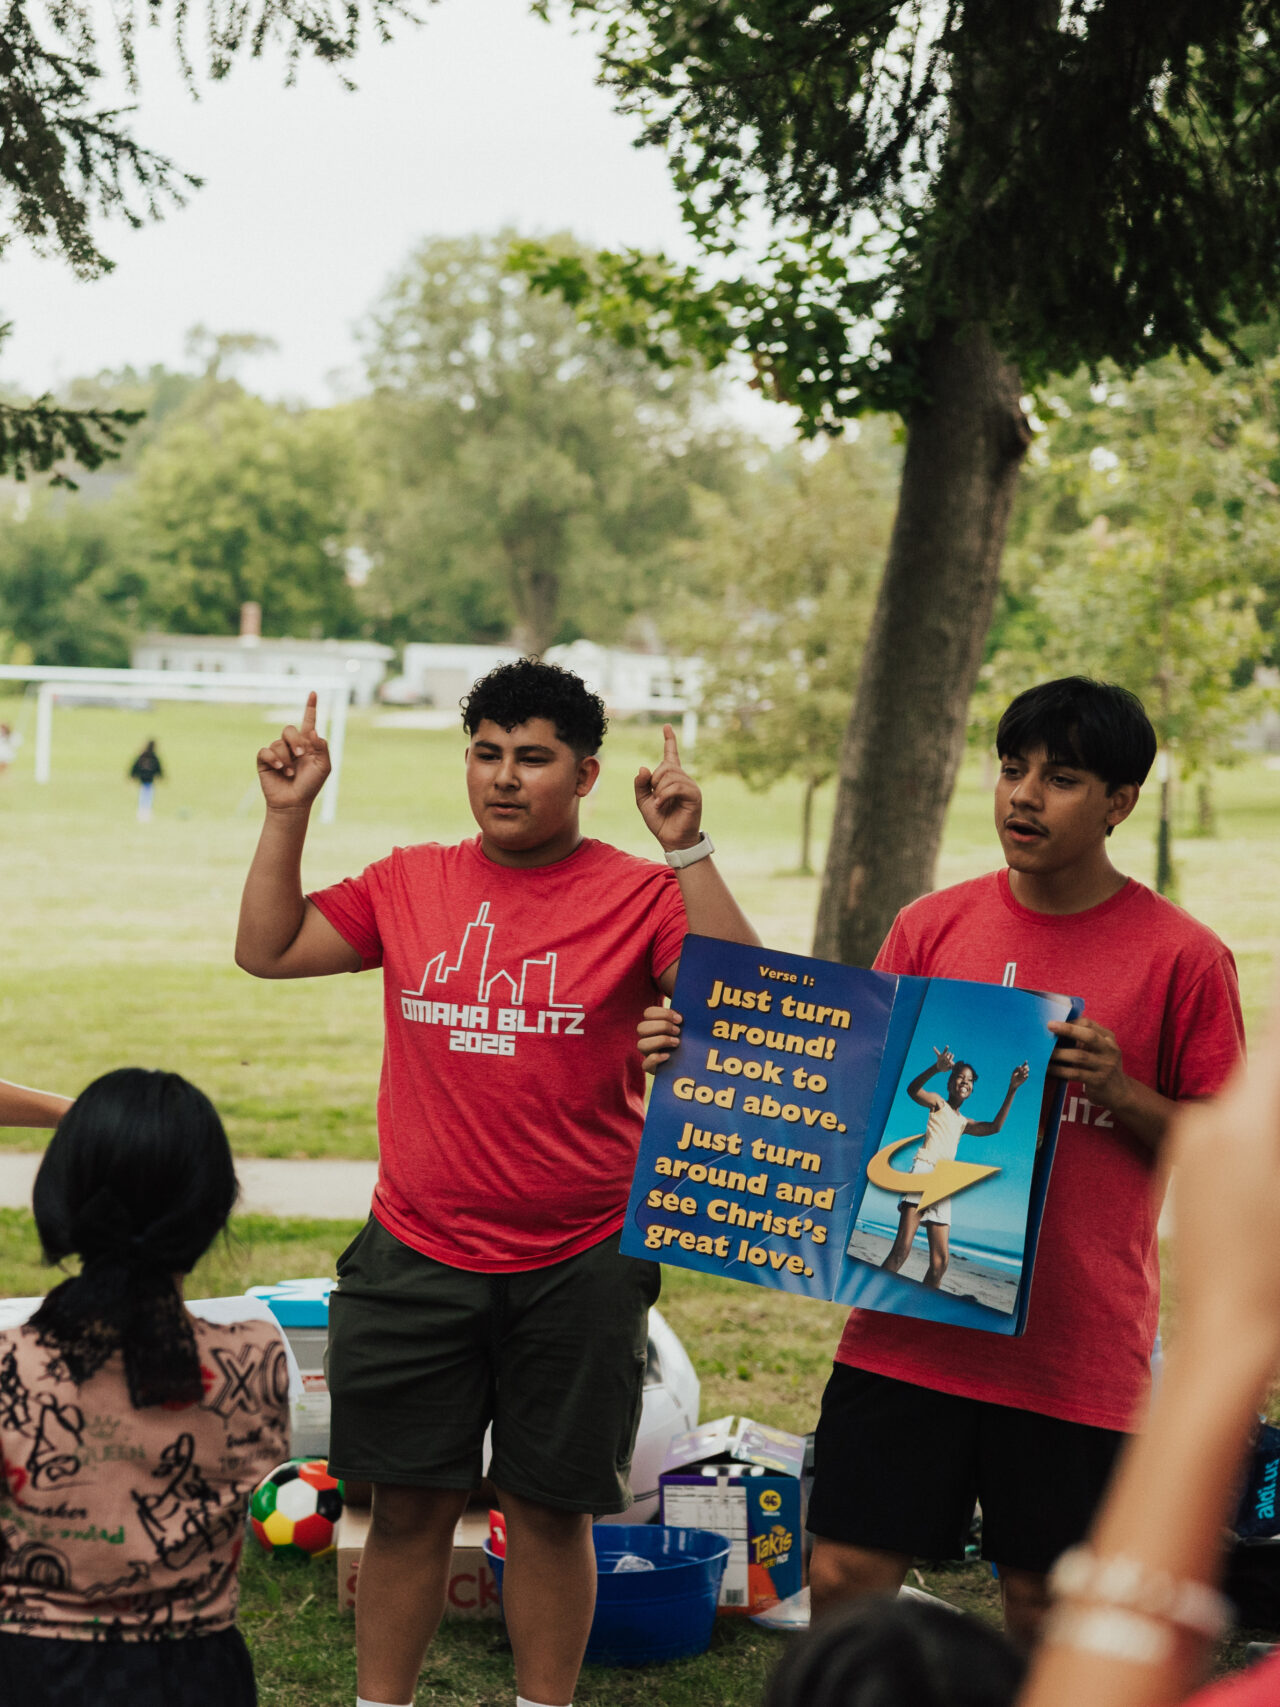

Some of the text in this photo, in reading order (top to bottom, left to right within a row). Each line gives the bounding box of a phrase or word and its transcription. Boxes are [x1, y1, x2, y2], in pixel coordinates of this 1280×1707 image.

[758, 965, 797, 983] Verse
[401, 997, 585, 1035] OMAHA BLITZ
[706, 980, 852, 1029] Just turn
[449, 1030, 516, 1056] 2026
[711, 1020, 836, 1060] around!
[705, 1048, 828, 1093] Look to
[672, 1077, 847, 1133] God above.
[676, 1122, 822, 1173] Just turn
[654, 1156, 836, 1211] around and
[647, 1189, 828, 1245] see Christ's
[644, 1224, 814, 1277] great love.
[751, 1532, 793, 1564] Takis
